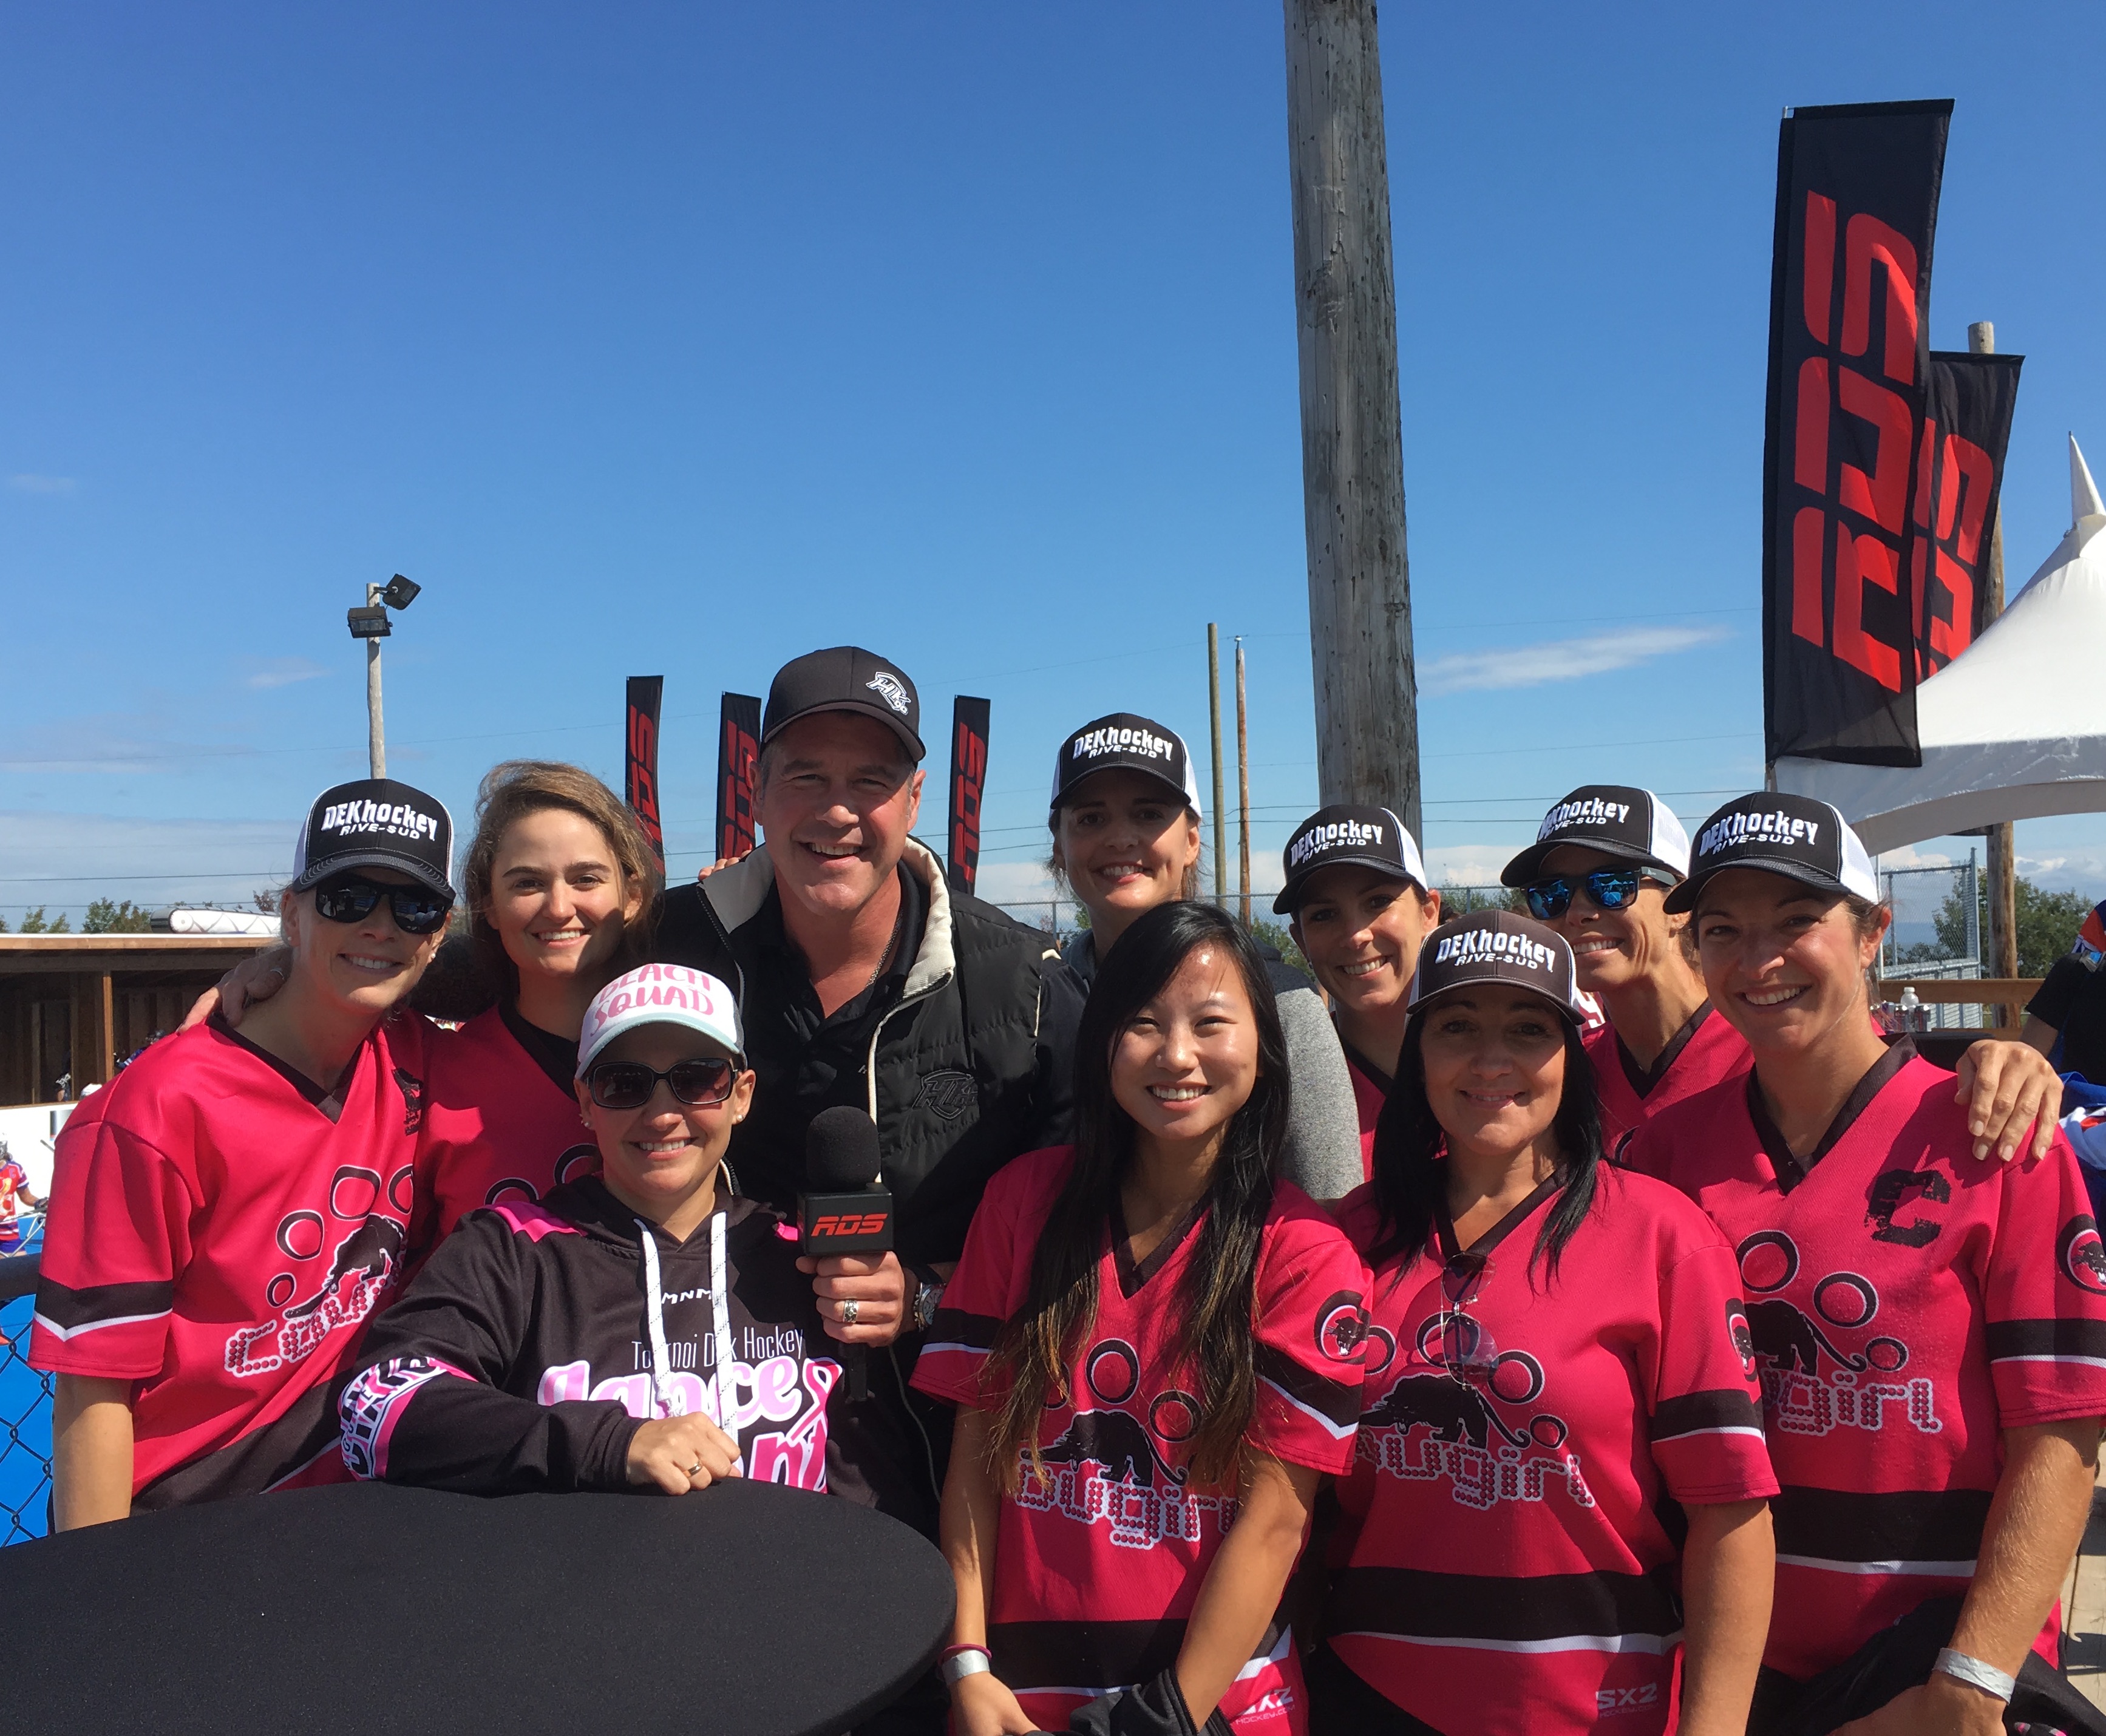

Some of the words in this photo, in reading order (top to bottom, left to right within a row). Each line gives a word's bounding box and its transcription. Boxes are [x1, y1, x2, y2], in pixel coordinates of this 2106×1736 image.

[1792, 189, 1918, 693] RDS
[1911, 416, 1994, 677] DS
[1088, 745, 1158, 759] RIVE-SUD
[954, 721, 986, 883] RDS
[339, 822, 420, 840] RIVE-SUD
[1712, 833, 1795, 855] RIVE-SUD
[1302, 838, 1367, 864] RIVE-SUD
[1455, 952, 1538, 970] RIVE-SUD
[598, 963, 710, 1005] BEACH
[589, 985, 715, 1037] SQUAD
[811, 1213, 888, 1237] RDS
[1864, 1169, 1952, 1249] C
[631, 1334, 698, 1371] Tonoi
[704, 1332, 738, 1368] Dk
[744, 1325, 803, 1360] Hockey
[1595, 1682, 1657, 1710] SX2
